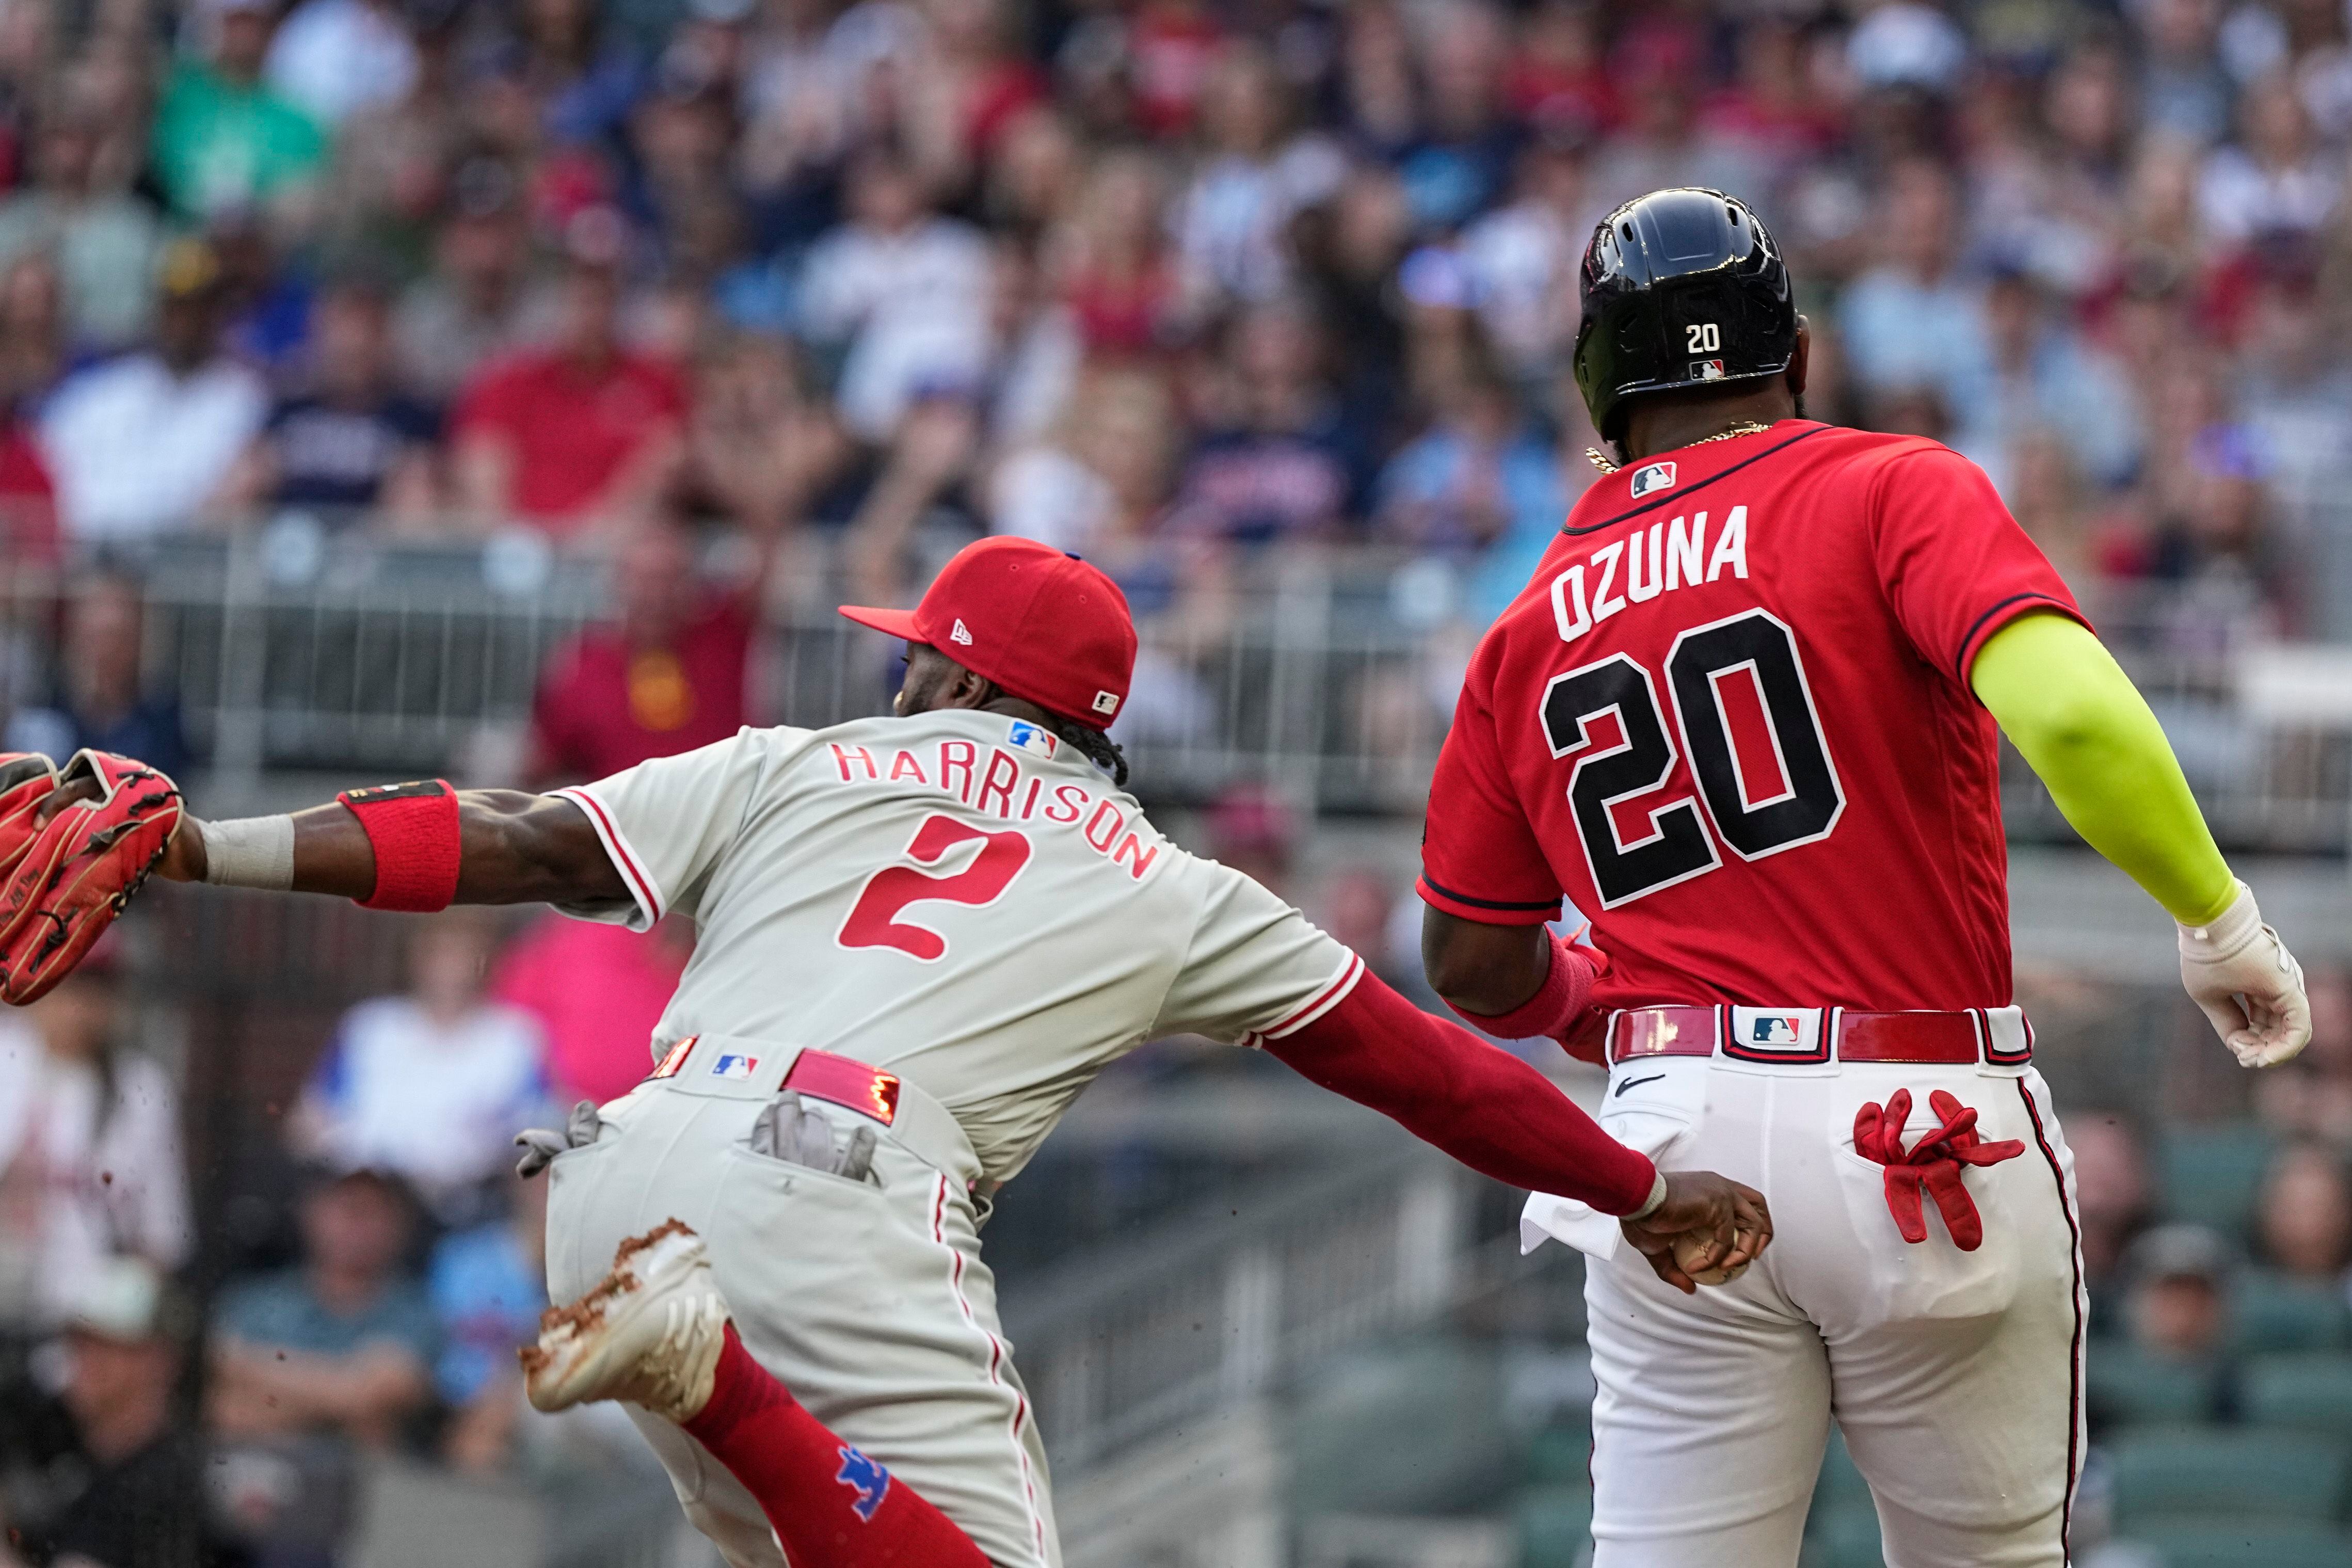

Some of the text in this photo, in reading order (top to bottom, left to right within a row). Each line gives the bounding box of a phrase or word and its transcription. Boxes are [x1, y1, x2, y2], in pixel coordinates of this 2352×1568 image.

[1686, 323, 1720, 354] 20
[1550, 505, 1749, 643] OZUNA
[827, 740, 1161, 883] HARRISON
[1539, 606, 1847, 911] 20
[834, 811, 1034, 964] 2
